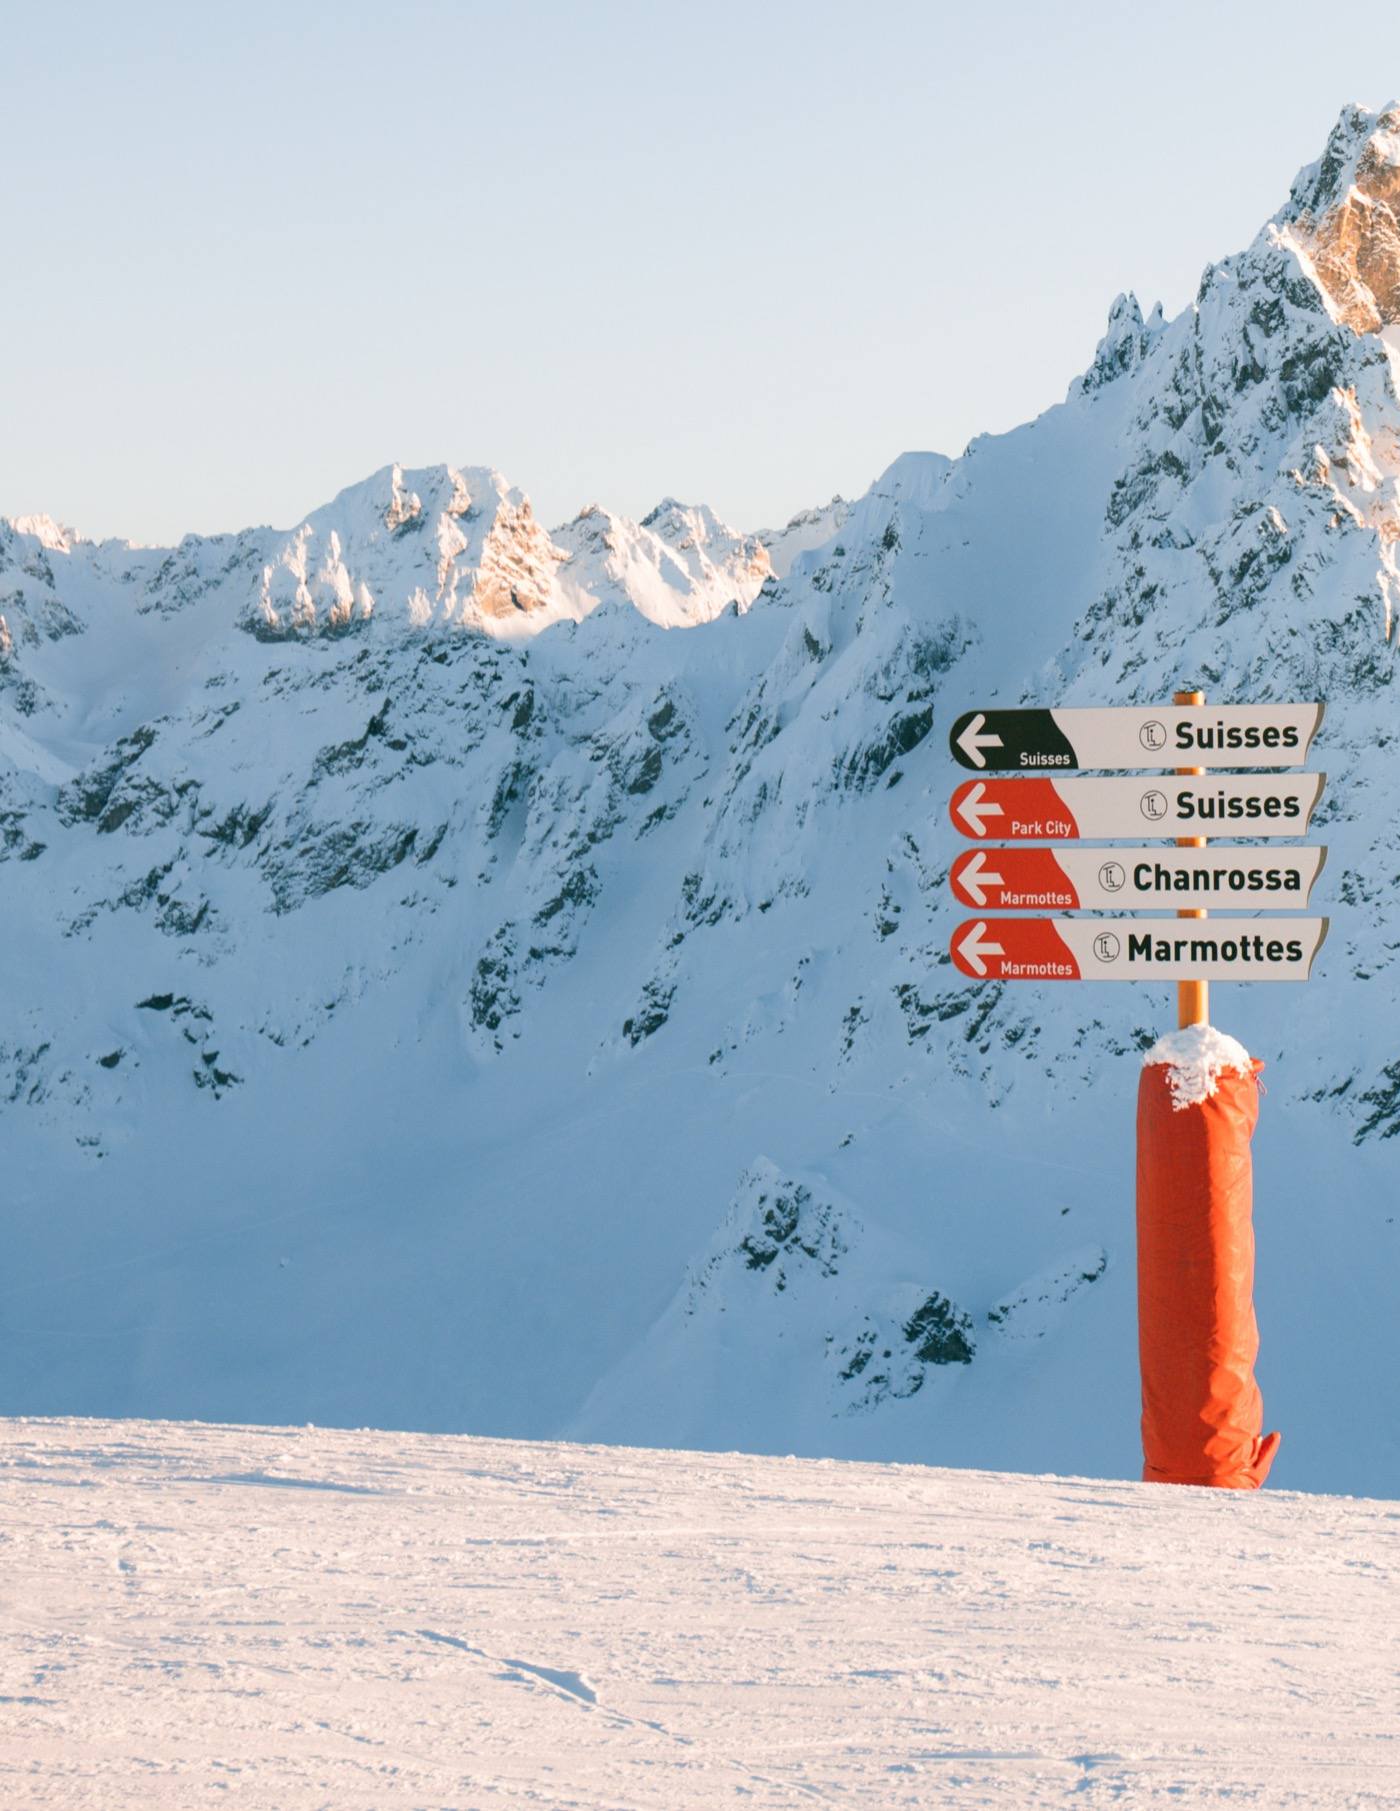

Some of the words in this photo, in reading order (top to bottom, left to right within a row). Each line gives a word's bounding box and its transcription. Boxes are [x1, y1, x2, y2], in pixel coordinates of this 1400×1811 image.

[1175, 721, 1299, 750] Suisses
[1020, 752, 1070, 766] Suisses
[1176, 791, 1300, 819] Suisses
[1011, 821, 1042, 835] Park
[1046, 821, 1071, 836] City
[1133, 863, 1301, 891] Chanrossa
[1001, 891, 1072, 905] Marmottes
[1128, 934, 1302, 962] Marmottes
[1001, 962, 1072, 975] Marmottes
